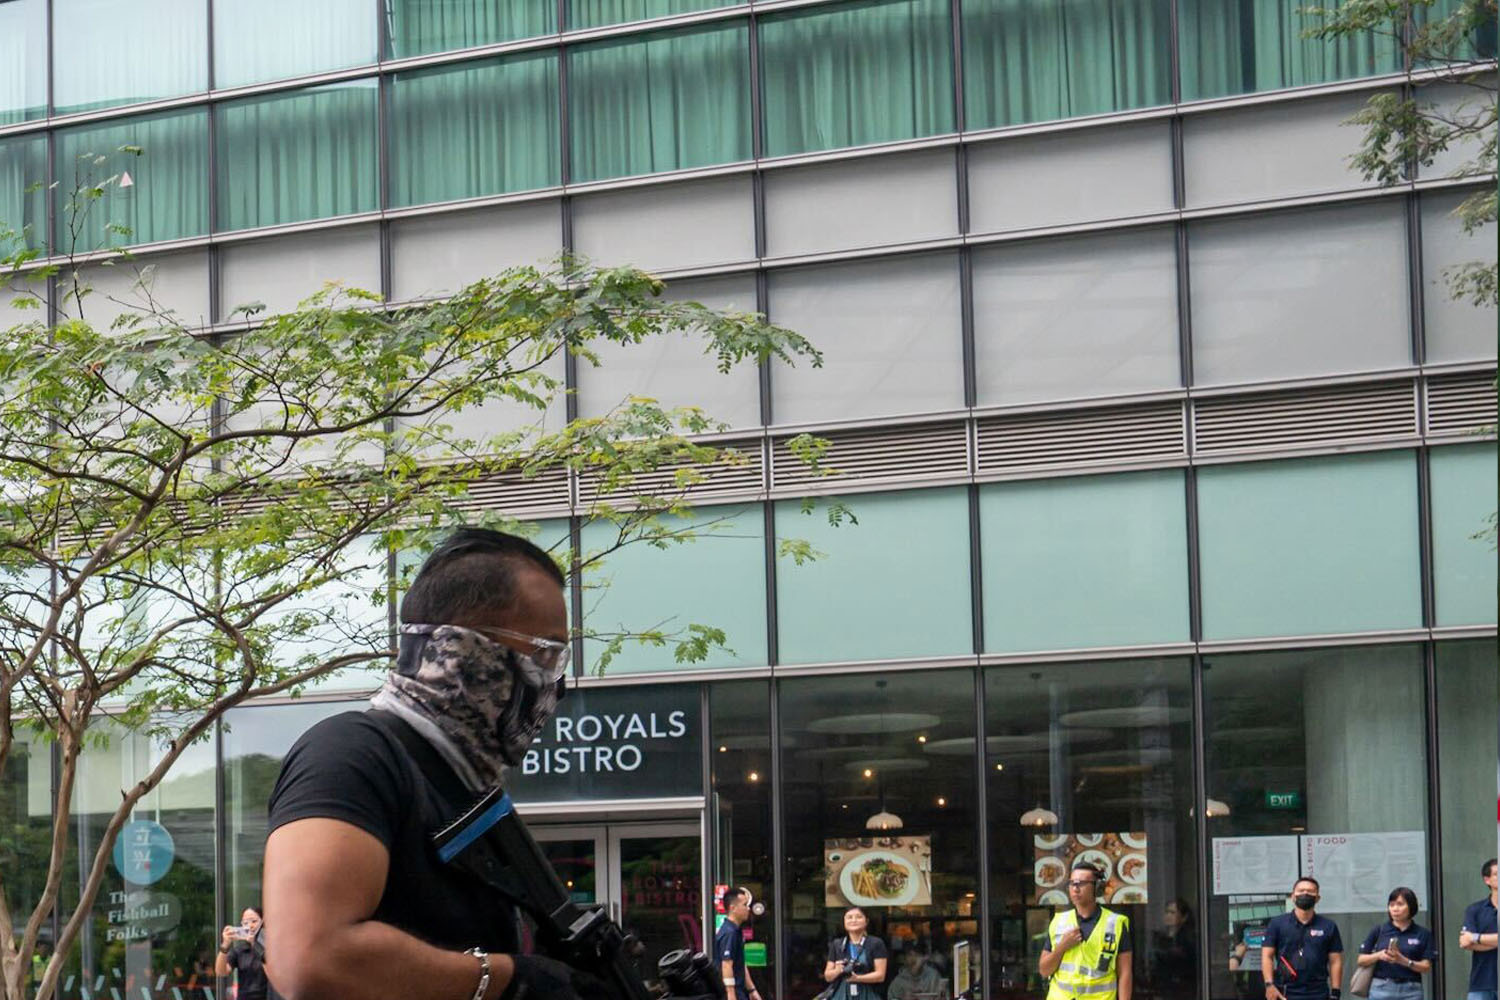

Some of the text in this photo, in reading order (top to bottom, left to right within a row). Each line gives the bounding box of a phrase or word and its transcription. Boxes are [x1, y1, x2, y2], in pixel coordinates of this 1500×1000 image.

[555, 710, 687, 742] ROYALS
[522, 744, 642, 775] BISTRO
[1270, 795, 1294, 807] EXIT
[1317, 836, 1347, 845] FOOD
[109, 891, 136, 904] The
[108, 903, 169, 923] Fishball
[106, 925, 149, 942] Folks
